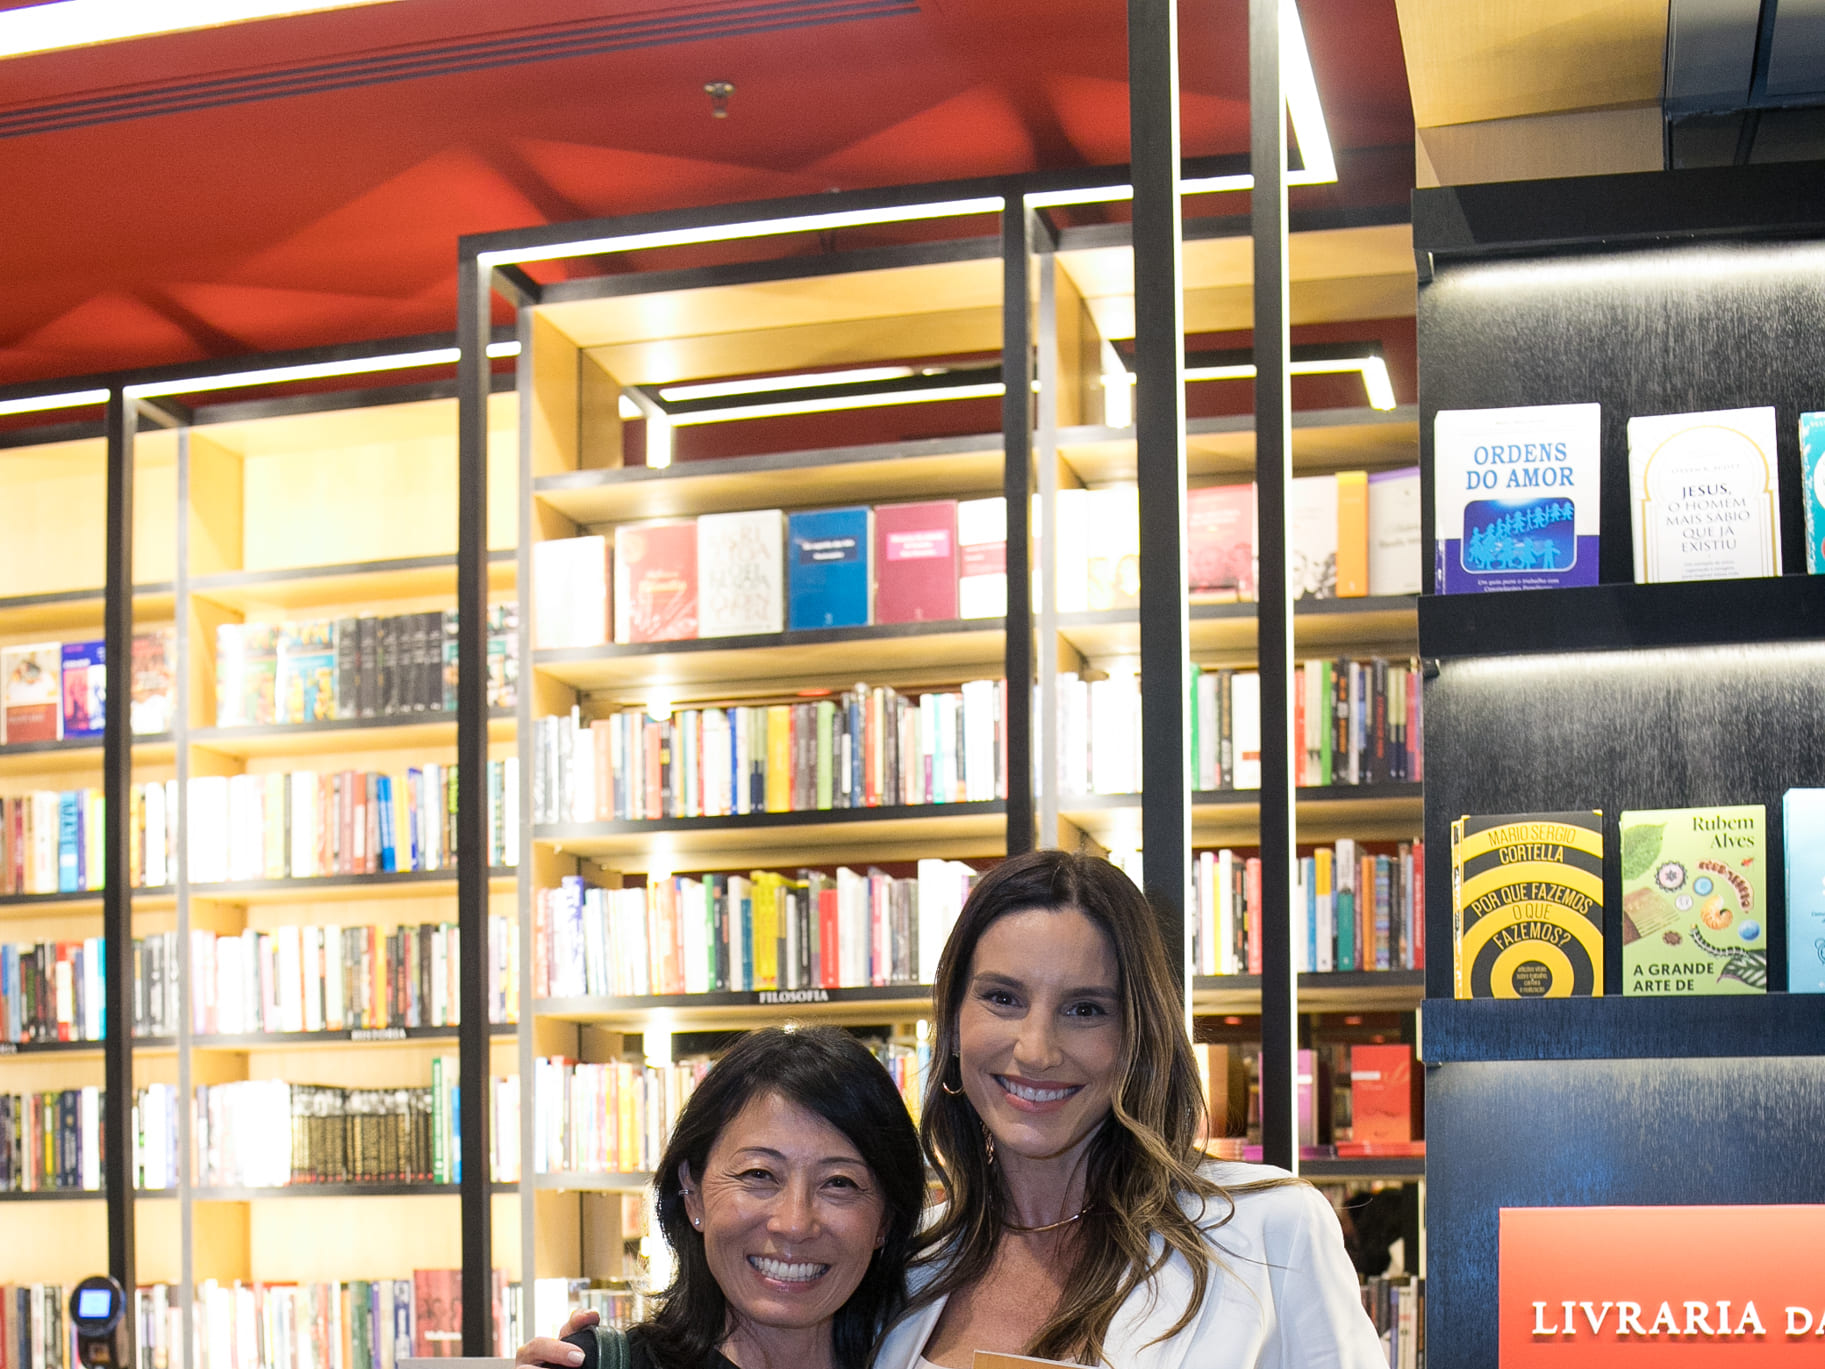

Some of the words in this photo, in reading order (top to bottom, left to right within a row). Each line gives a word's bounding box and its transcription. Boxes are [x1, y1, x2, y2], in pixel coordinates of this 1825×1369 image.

[1474, 442, 1567, 465] ORDENS
[1466, 470, 1498, 490] DO
[1506, 467, 1574, 488] AMOR
[1682, 483, 1732, 499] JESUS,
[1668, 502, 1680, 512] O
[1685, 498, 1747, 511] HOMEM
[1666, 513, 1702, 526] MAIS
[1682, 526, 1713, 541] QUE
[1682, 538, 1737, 553] EXISTIU
[1692, 815, 1755, 831] Rubem
[1488, 827, 1529, 847] MARIO
[1530, 828, 1577, 844] SERGIO
[1710, 833, 1755, 848] Alves
[1499, 844, 1564, 864] CORTELLA
[1471, 891, 1501, 918] POR
[1501, 883, 1528, 901] QUE
[1531, 883, 1594, 916] FAZEMOS
[1512, 904, 1522, 921] O
[1525, 903, 1553, 920] QUE
[1492, 922, 1572, 950] FAZEMOS?
[1633, 964, 1644, 976] A
[1648, 962, 1714, 976] GRANDE
[1633, 980, 1671, 992] ARTE
[1676, 979, 1694, 991] DE
[759, 990, 829, 1004] FILOSOFIA
[1532, 1300, 1767, 1336] LIVRARIA
